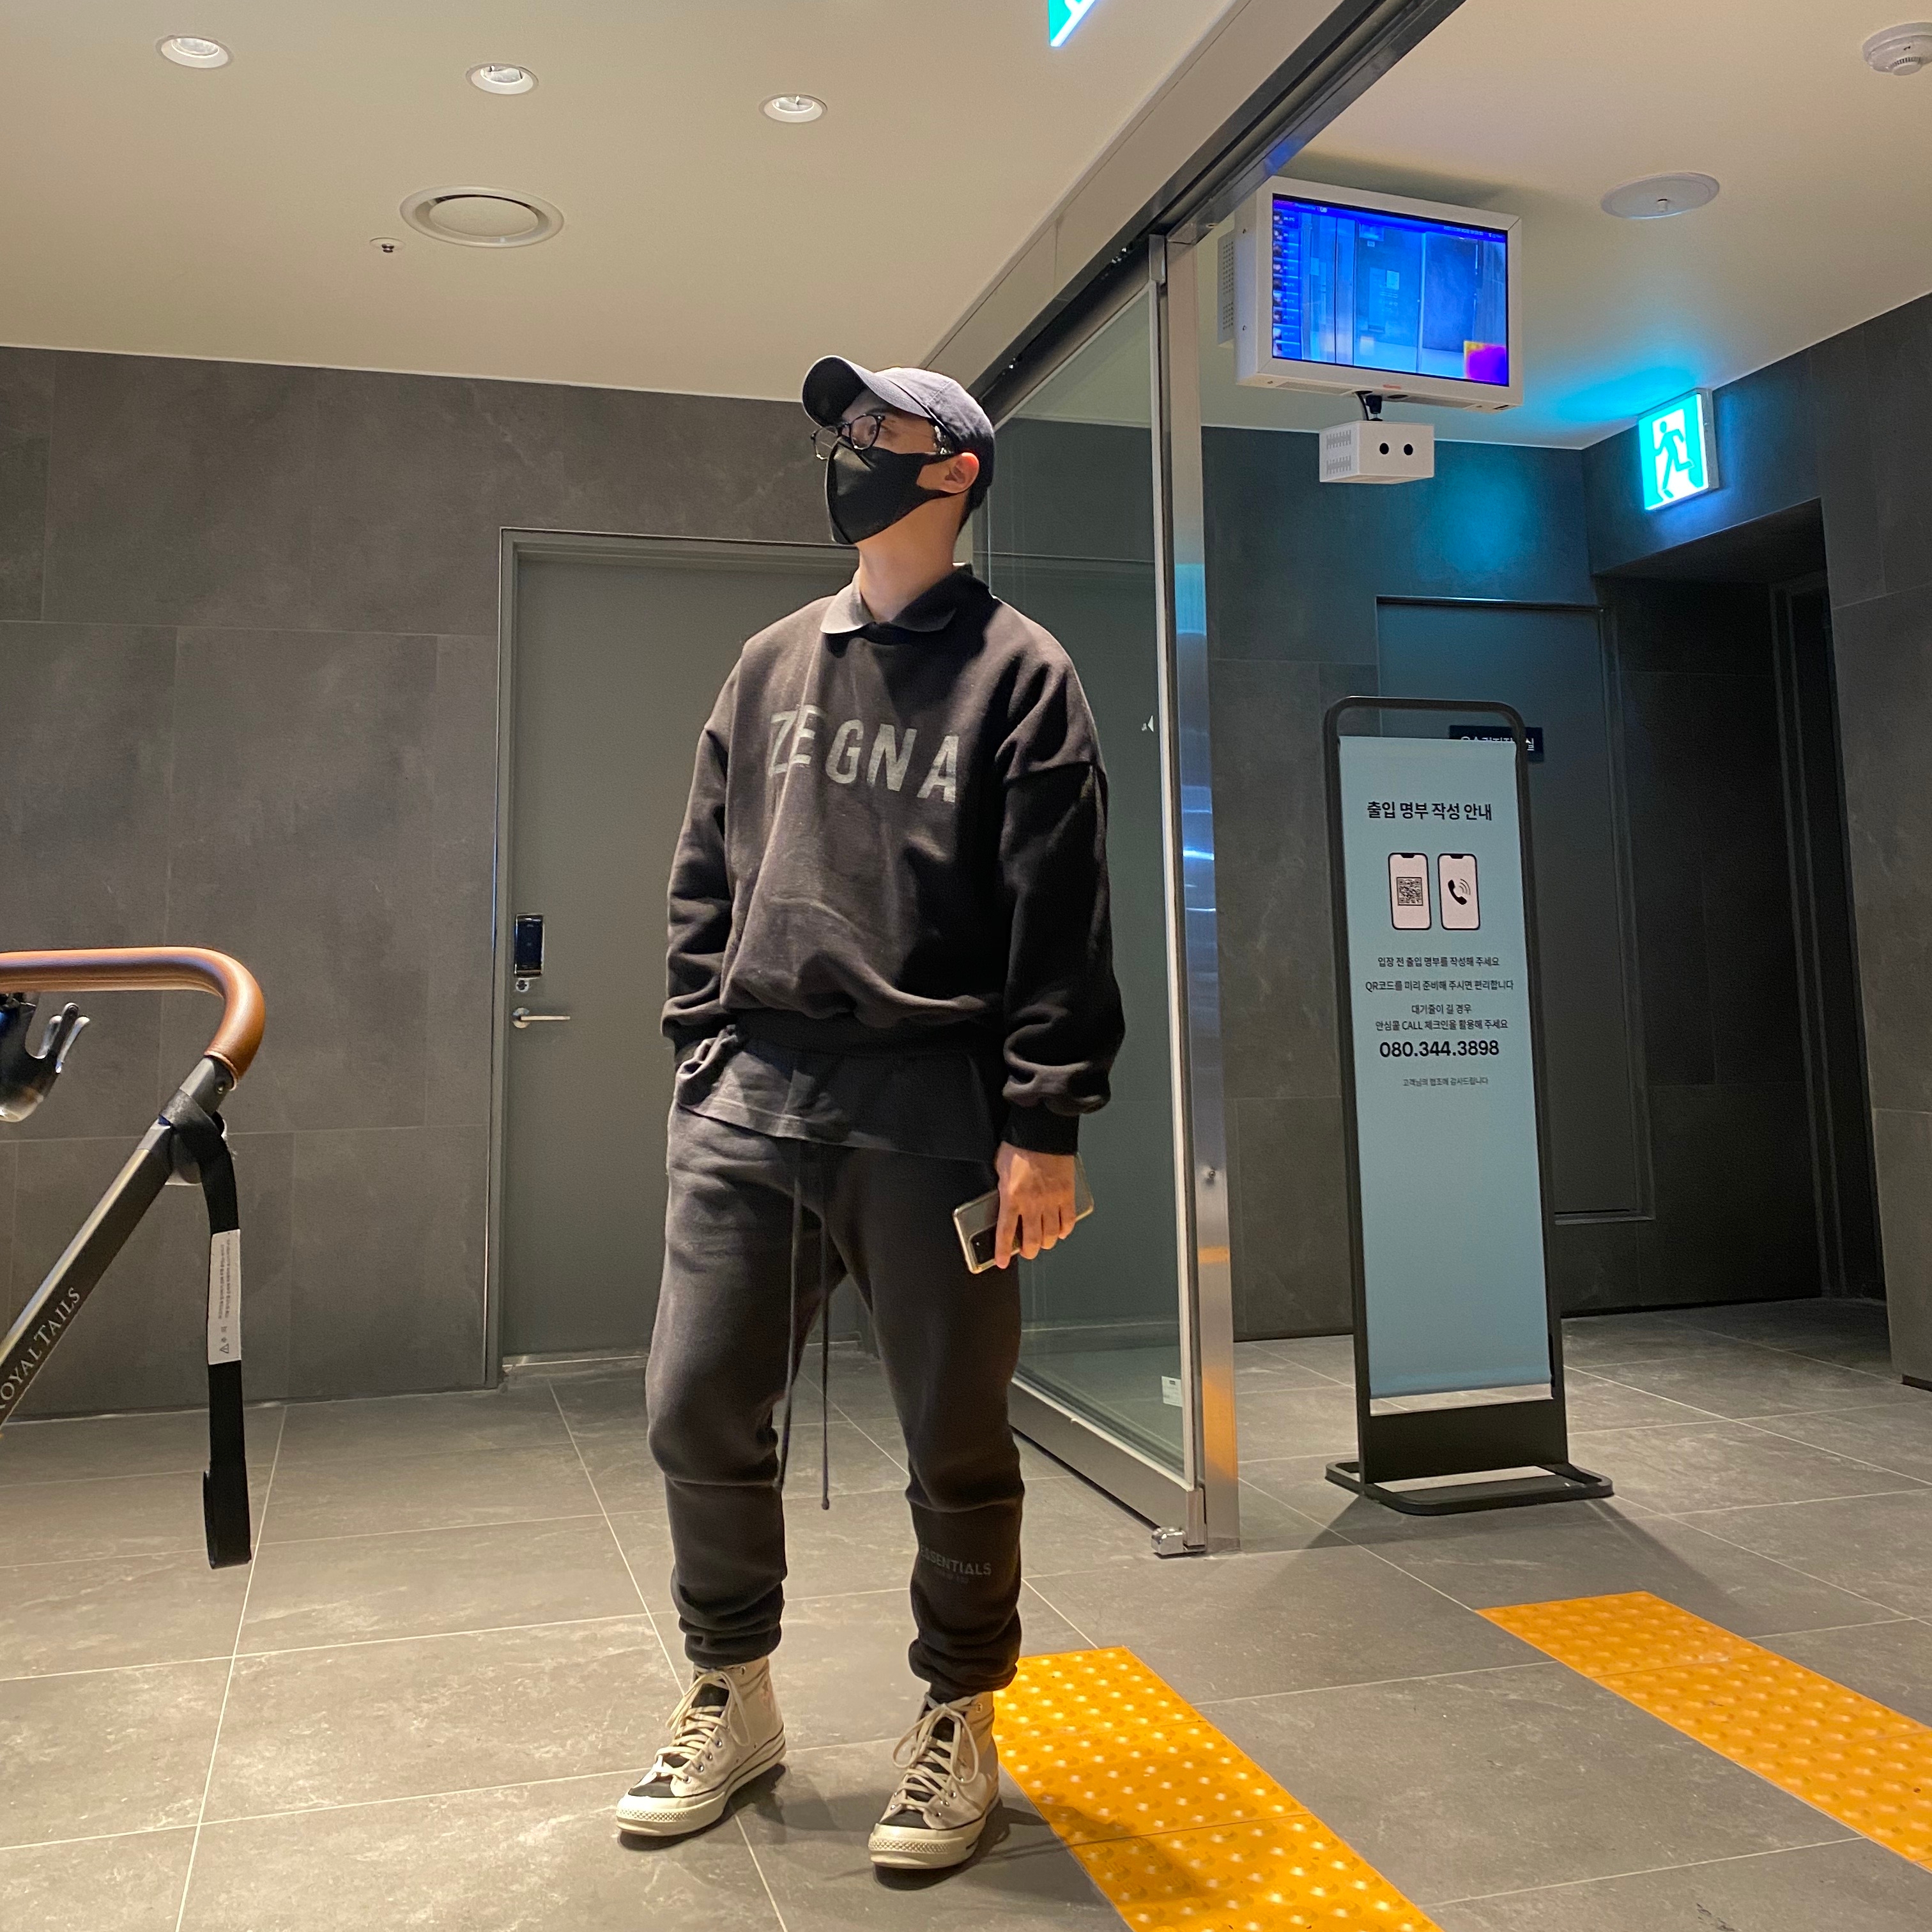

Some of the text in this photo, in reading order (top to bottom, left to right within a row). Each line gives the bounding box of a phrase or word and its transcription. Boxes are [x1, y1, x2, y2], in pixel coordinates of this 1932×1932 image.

[769, 704, 959, 803] ZEGNA
[1367, 801, 1492, 820] 출입 명부 작성 안내
[1378, 957, 1499, 967] 입장 전 출입 명부를 작성해 주세요
[1405, 981, 1420, 990] 미리
[1423, 981, 1446, 990] 준비해
[1449, 981, 1473, 990] 주시면
[1475, 980, 1514, 990] 편리합니다
[1412, 1004, 1472, 1015] 대기줄이 길 경우
[1402, 1021, 1423, 1030] CALL
[1485, 1019, 1508, 1029] 주세요
[1380, 1040, 1499, 1057] 080.344.3898
[0, 1287, 80, 1409] OYAL TAILS
